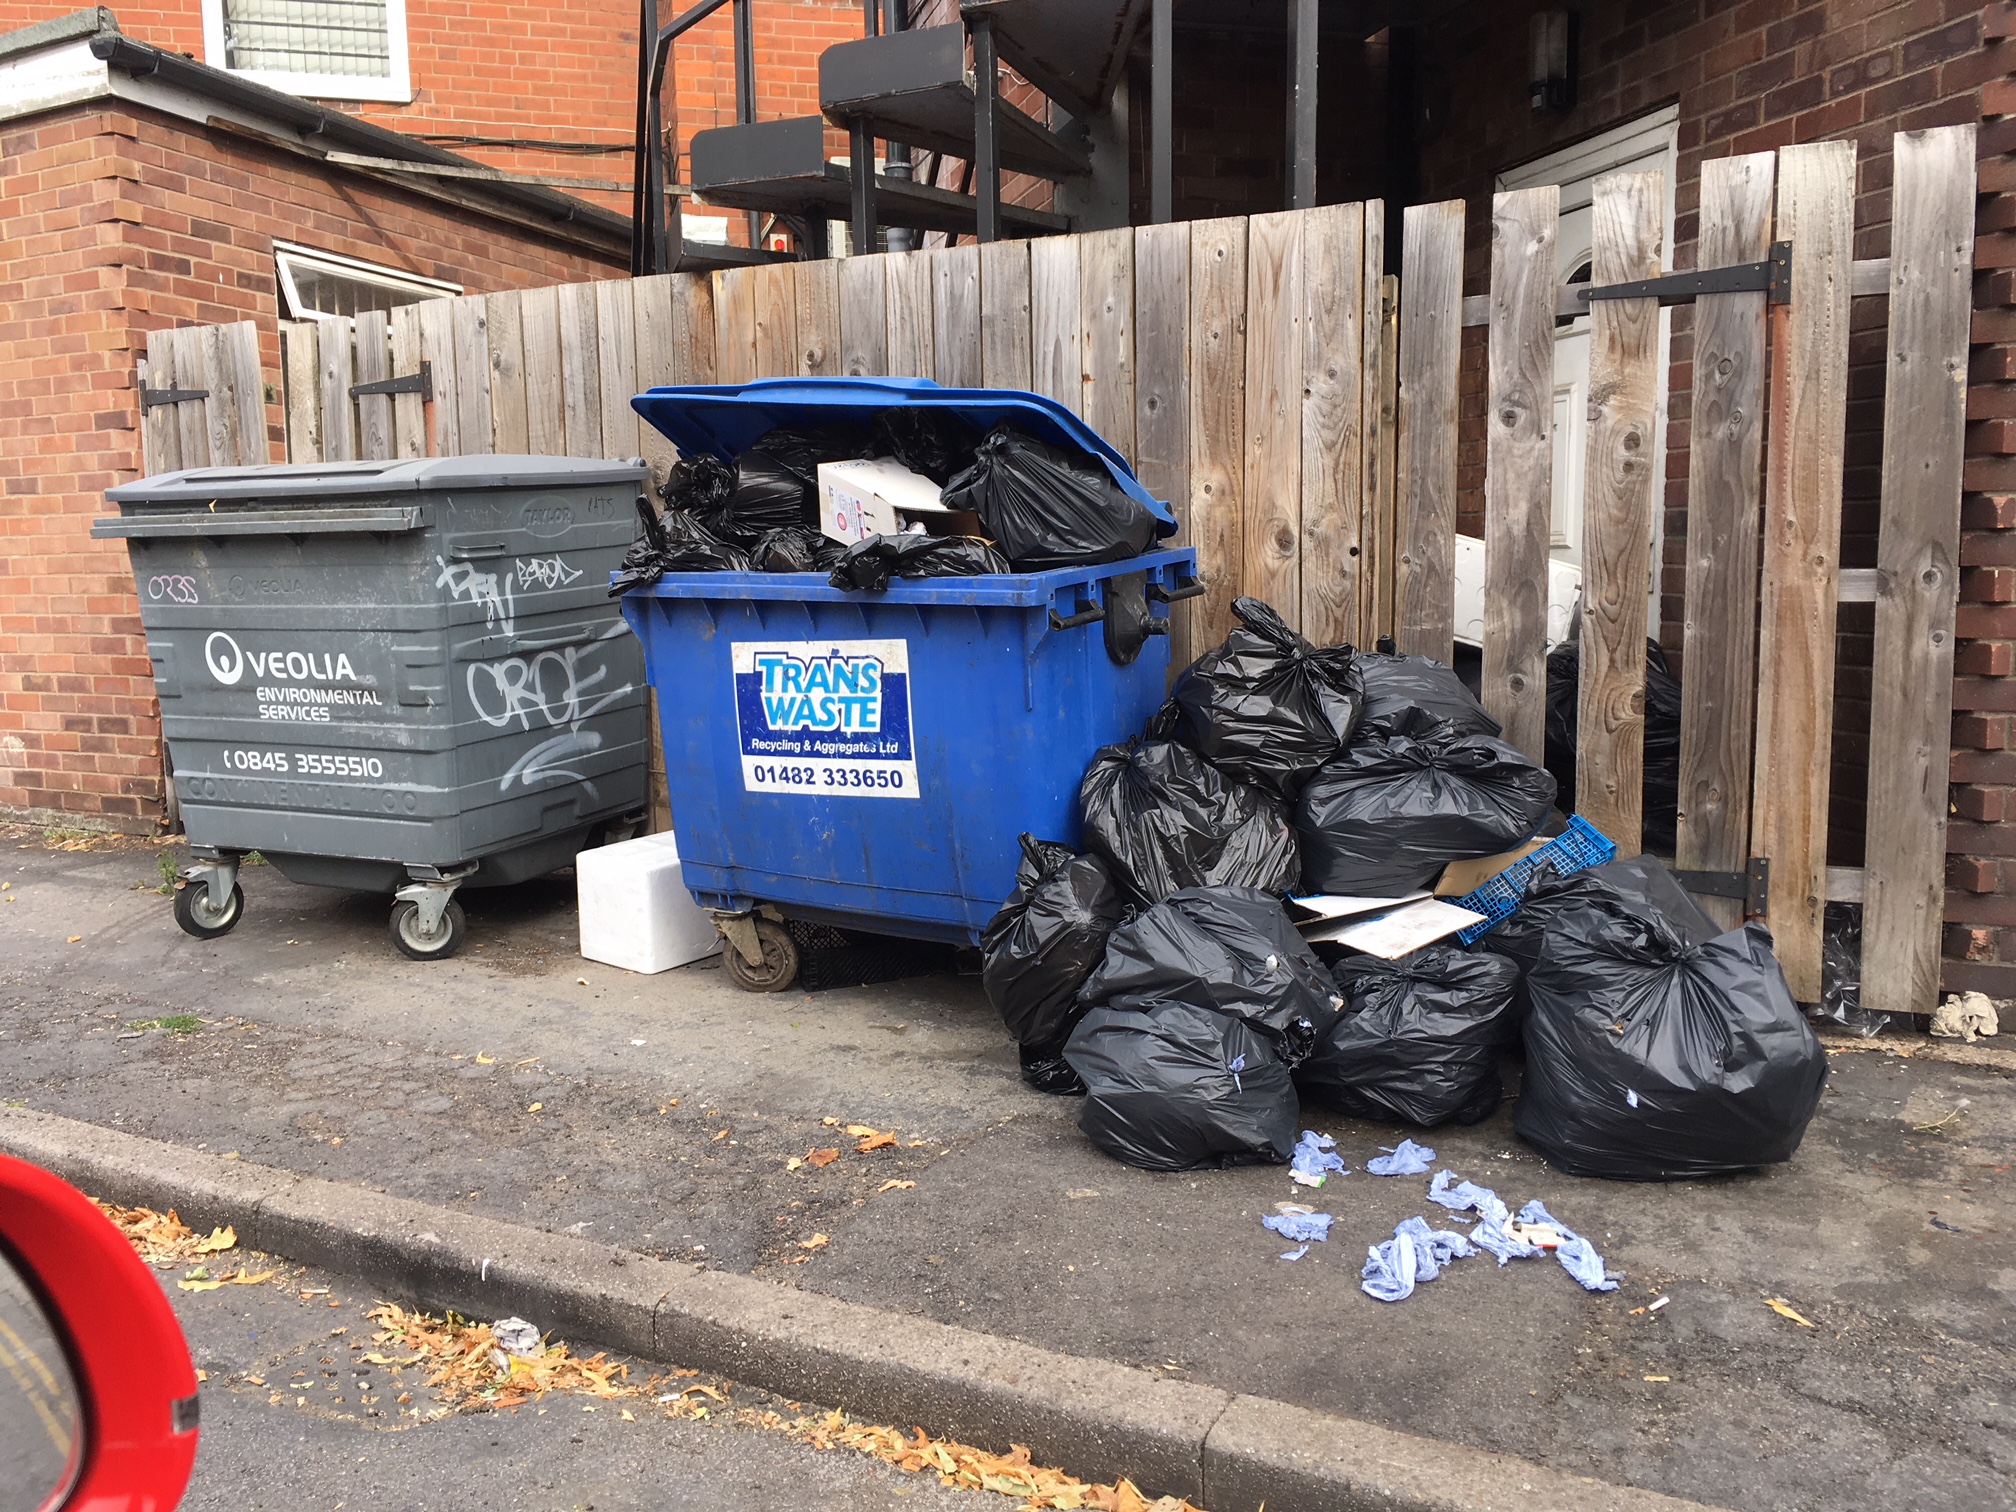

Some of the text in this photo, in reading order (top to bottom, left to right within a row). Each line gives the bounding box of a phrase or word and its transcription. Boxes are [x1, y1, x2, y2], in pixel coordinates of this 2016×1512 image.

[524, 507, 572, 527] TAYLOR
[245, 650, 357, 681] VEOLIA
[758, 658, 879, 695] TRANS
[256, 686, 383, 706] ENVIRONMENTAL
[258, 704, 331, 722] SERVICES
[763, 695, 878, 728] WASTE
[751, 738, 899, 755] Recycling & Aggregates Ltd
[234, 750, 383, 778] 0845 3555510
[754, 765, 903, 789] 01482 333650
